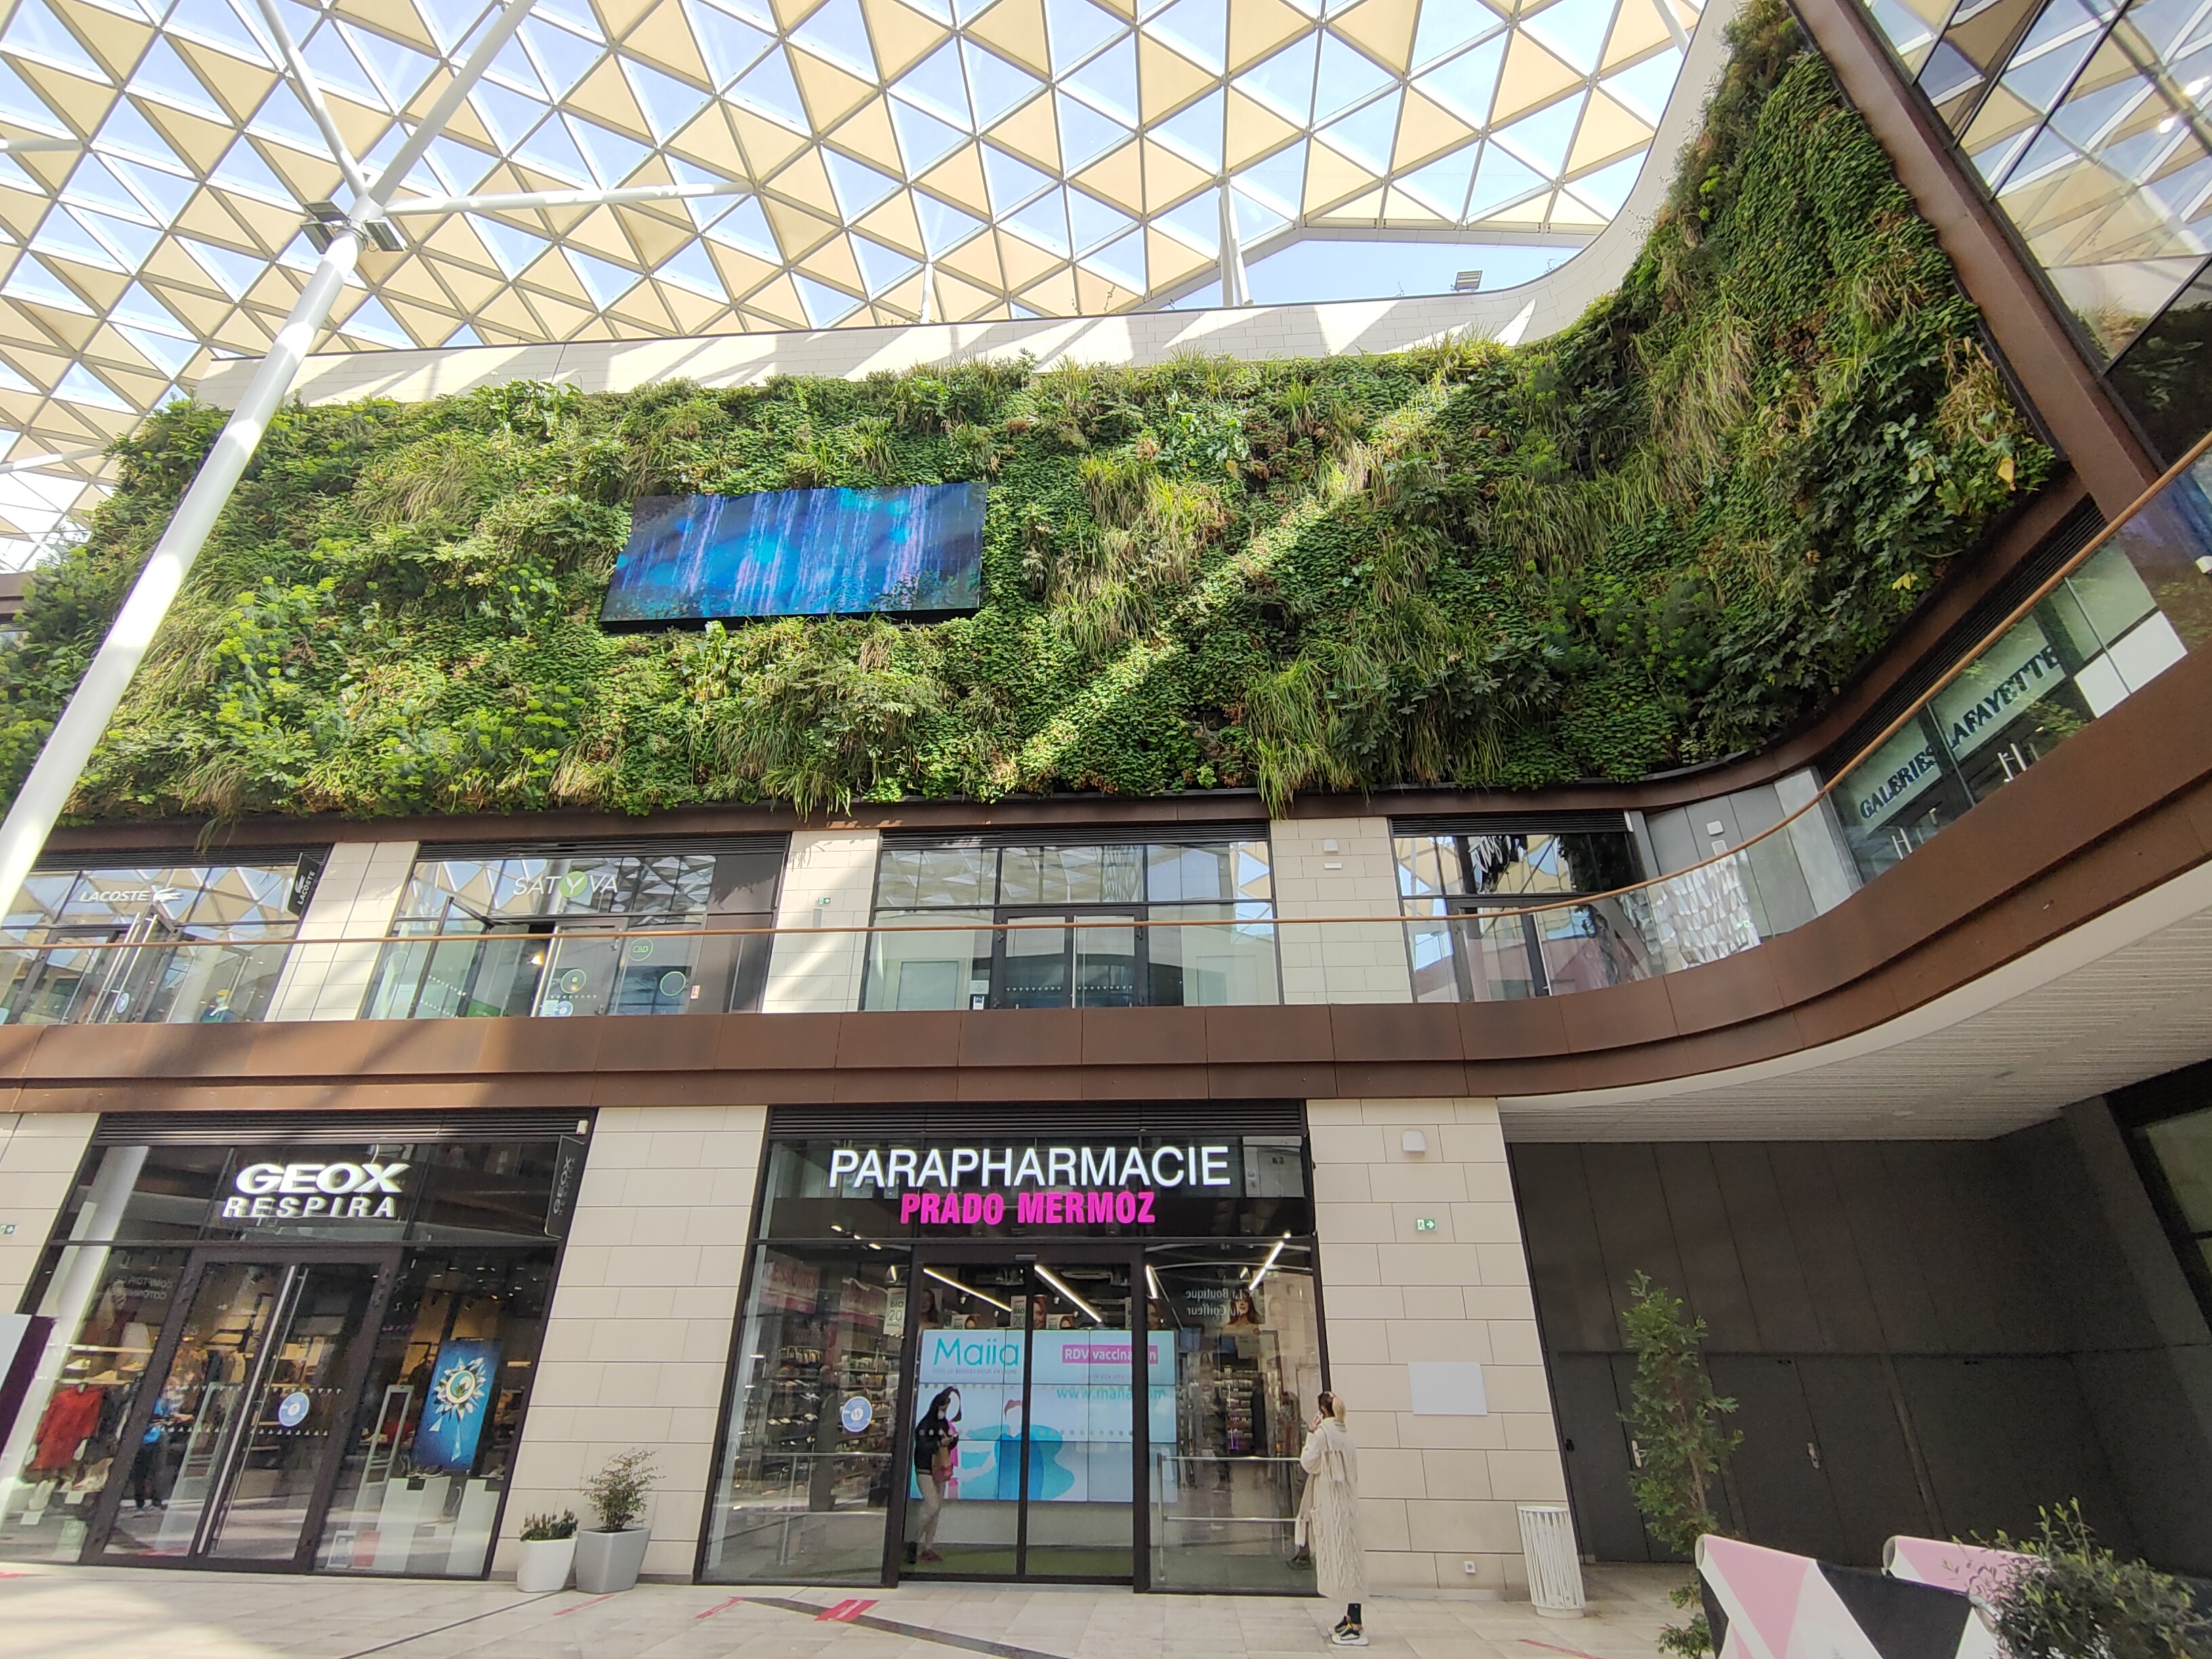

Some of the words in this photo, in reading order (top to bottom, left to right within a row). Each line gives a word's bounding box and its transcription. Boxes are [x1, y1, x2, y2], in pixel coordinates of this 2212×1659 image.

[1860, 743, 1937, 819] GALERIES
[79, 890, 151, 902] LACOSTE
[297, 870, 316, 905] LACOSTE
[236, 1163, 411, 1195] GEOX
[829, 1146, 1231, 1188] PARAPHARMACIE
[553, 1155, 572, 1214] GEOX
[222, 1197, 397, 1218] RESPIRA
[900, 1193, 1004, 1225] PRADO
[1017, 1191, 1155, 1224] MERMOZ
[888, 1309, 903, 1322] 20
[1012, 1315, 1025, 1326] 20
[933, 1338, 1019, 1366] Maiia
[1065, 1349, 1089, 1360] RDV
[1092, 1348, 1157, 1361] vaccinan
